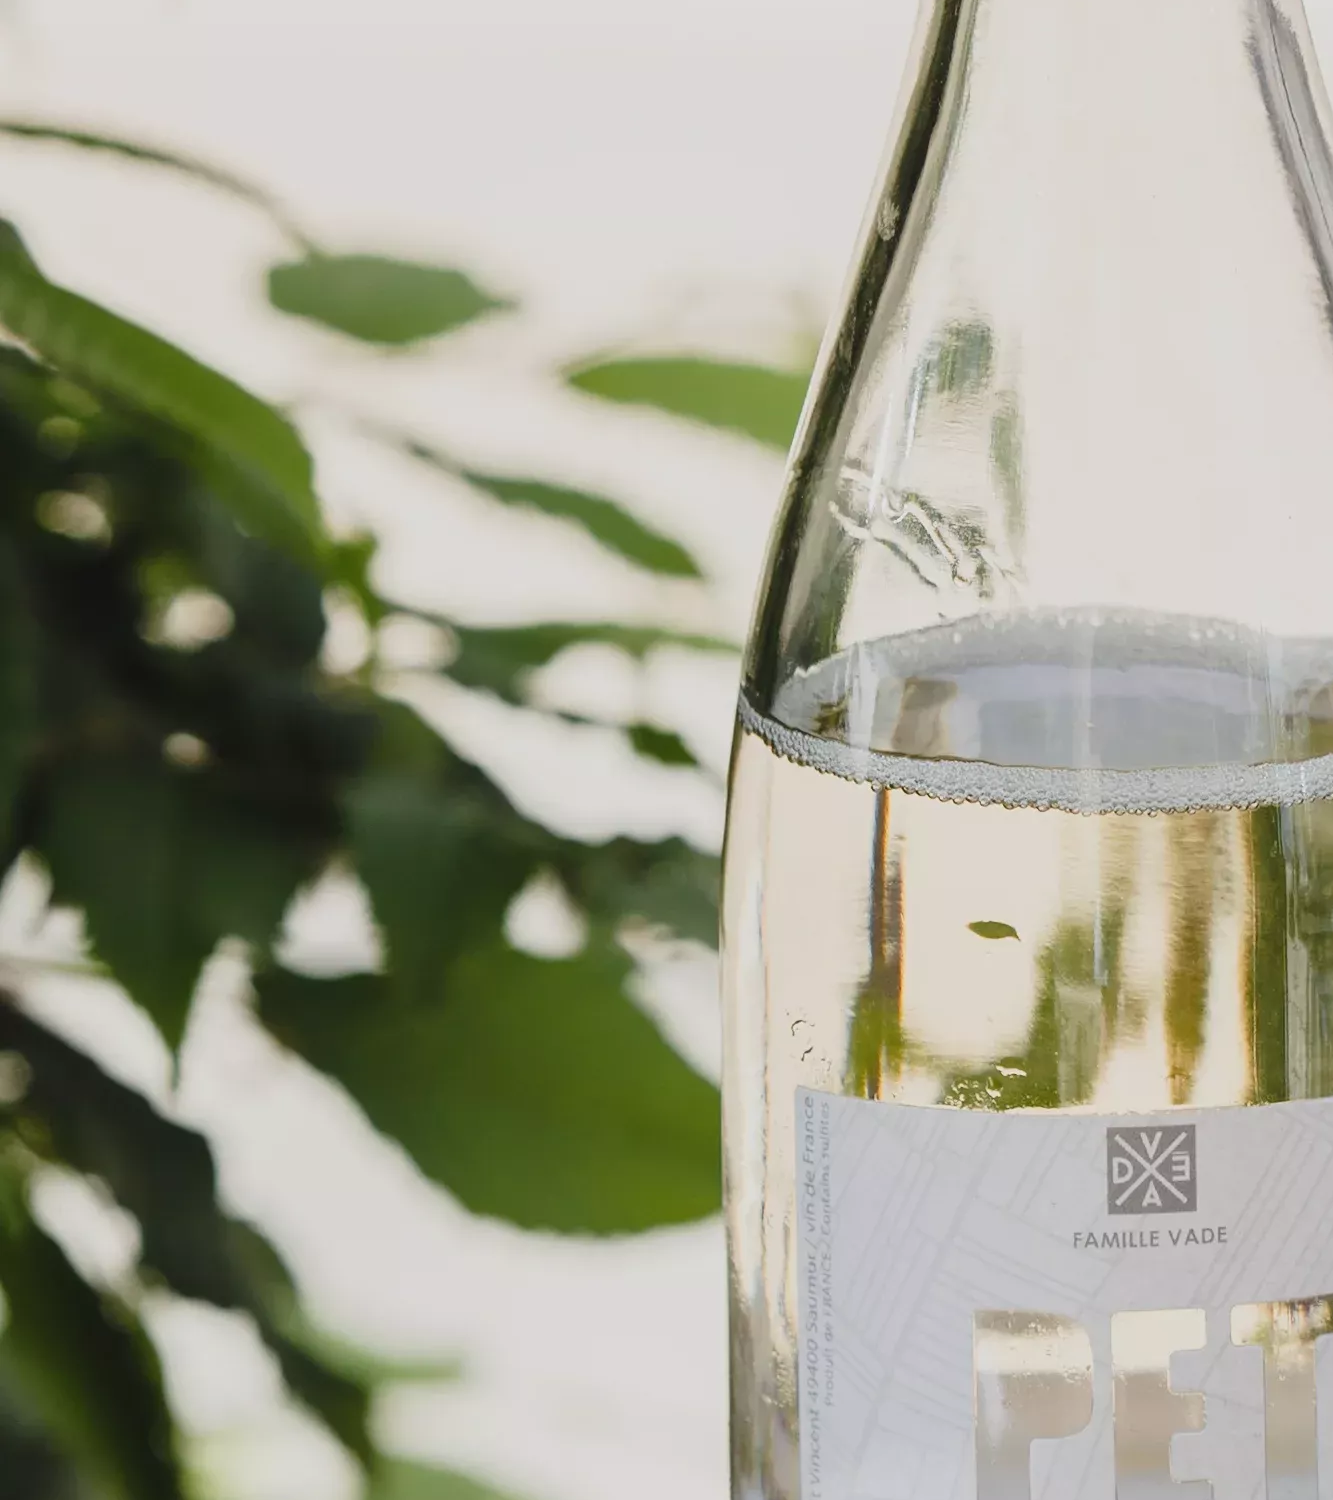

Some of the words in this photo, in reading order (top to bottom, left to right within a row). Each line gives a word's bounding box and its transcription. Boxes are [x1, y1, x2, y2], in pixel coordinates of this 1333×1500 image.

[802, 1095, 814, 1165] France
[803, 1170, 815, 1197] de
[803, 1203, 816, 1233] vin
[1073, 1230, 1159, 1249] FAMILLE
[1168, 1226, 1228, 1246] VADE
[805, 1252, 818, 1334] Saumur
[805, 1338, 818, 1403] 49400
